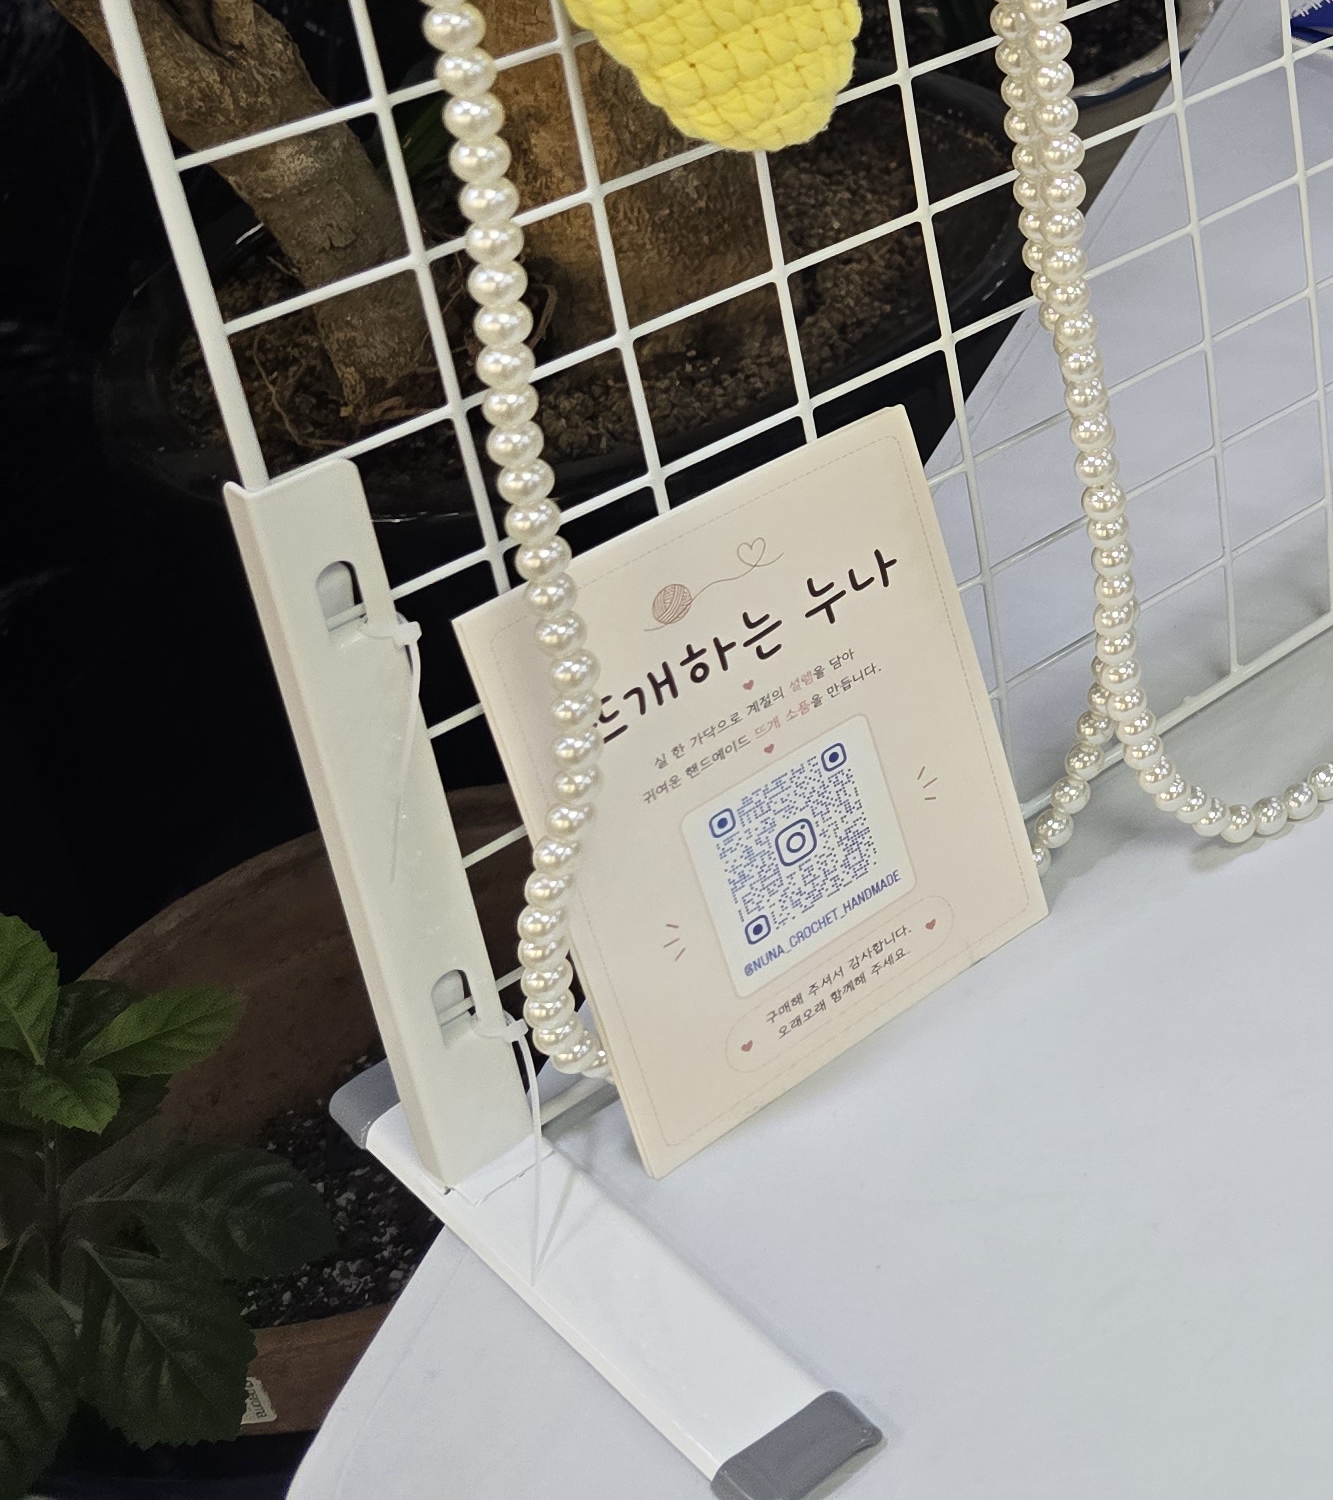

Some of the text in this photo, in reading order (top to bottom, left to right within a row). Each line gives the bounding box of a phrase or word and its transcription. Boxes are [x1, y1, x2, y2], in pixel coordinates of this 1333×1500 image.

[805, 549, 897, 624] 누나
[643, 662, 882, 805] 귀여운 핸드메이드 뜨개 소품을 만듭니다.
[654, 648, 854, 769] 실 한 가닥으로 계절의 설렘을 담아
[744, 869, 901, 977] @NUNA_CROCHET_HANDMADE
[766, 925, 912, 1024] 구매해 주셔서 감사합니다.
[778, 947, 910, 1039] 오래오래 함께해 주세요.
